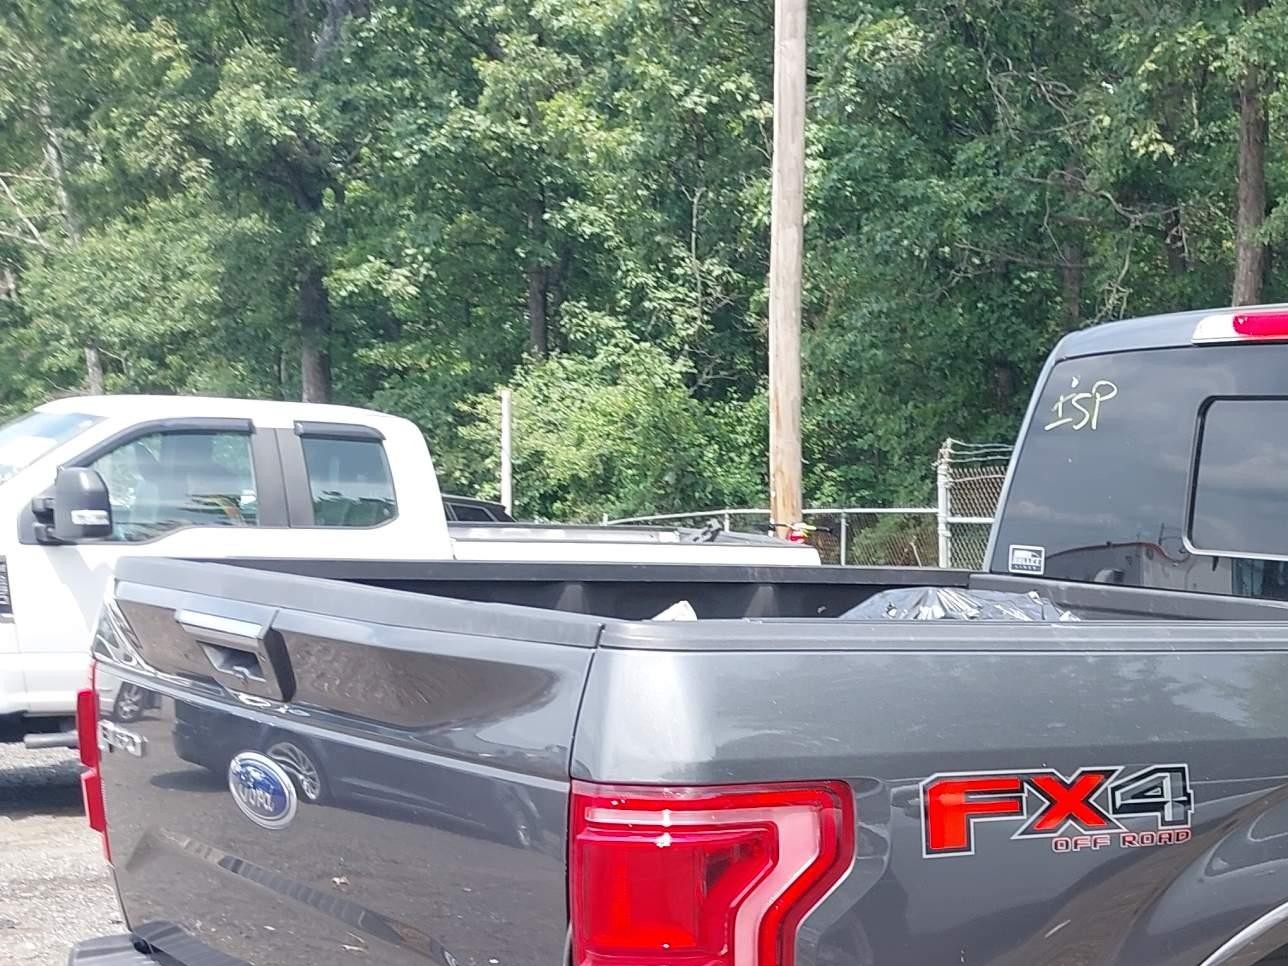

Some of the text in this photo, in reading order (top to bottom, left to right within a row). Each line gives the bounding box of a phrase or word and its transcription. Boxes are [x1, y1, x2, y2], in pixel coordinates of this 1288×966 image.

[919, 764, 1195, 858] FX4
[1051, 829, 1193, 853] OFF ROAD
